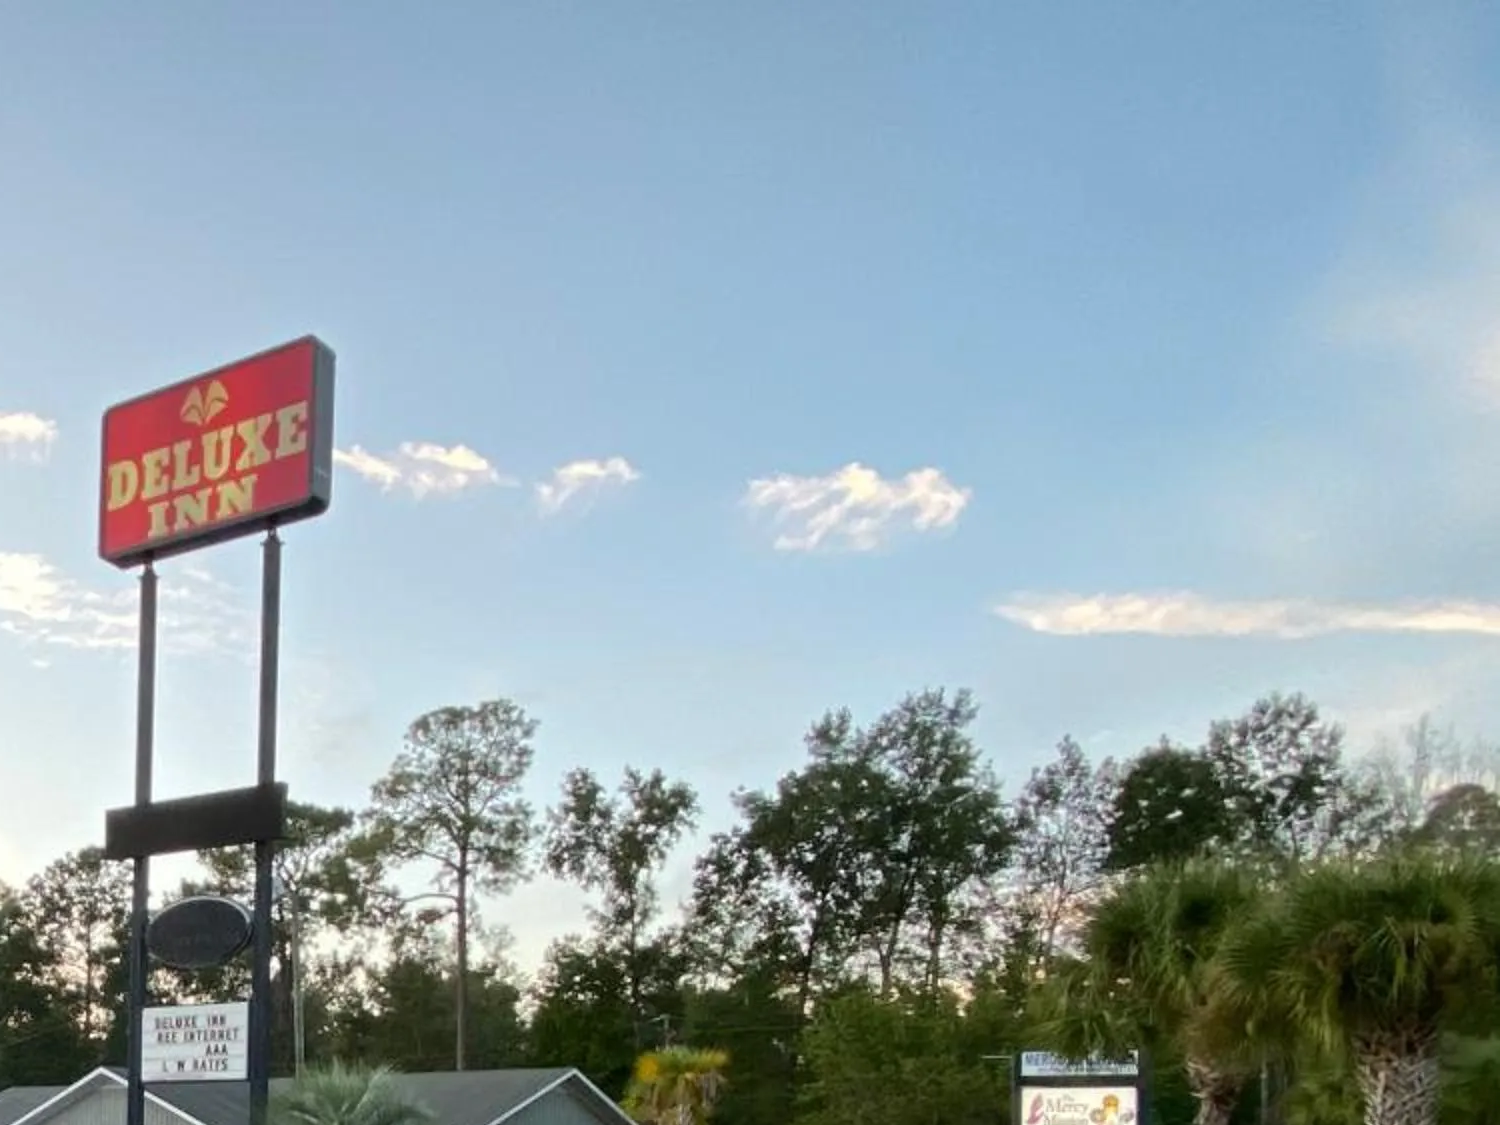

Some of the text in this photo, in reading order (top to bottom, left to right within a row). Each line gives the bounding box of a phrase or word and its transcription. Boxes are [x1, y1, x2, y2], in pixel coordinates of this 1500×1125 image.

[107, 401, 308, 511] DELUXE
[148, 474, 258, 539] INN
[155, 1014, 197, 1030] DELUXE
[184, 1027, 238, 1042] INTERNET
[205, 1043, 228, 1056] AAA
